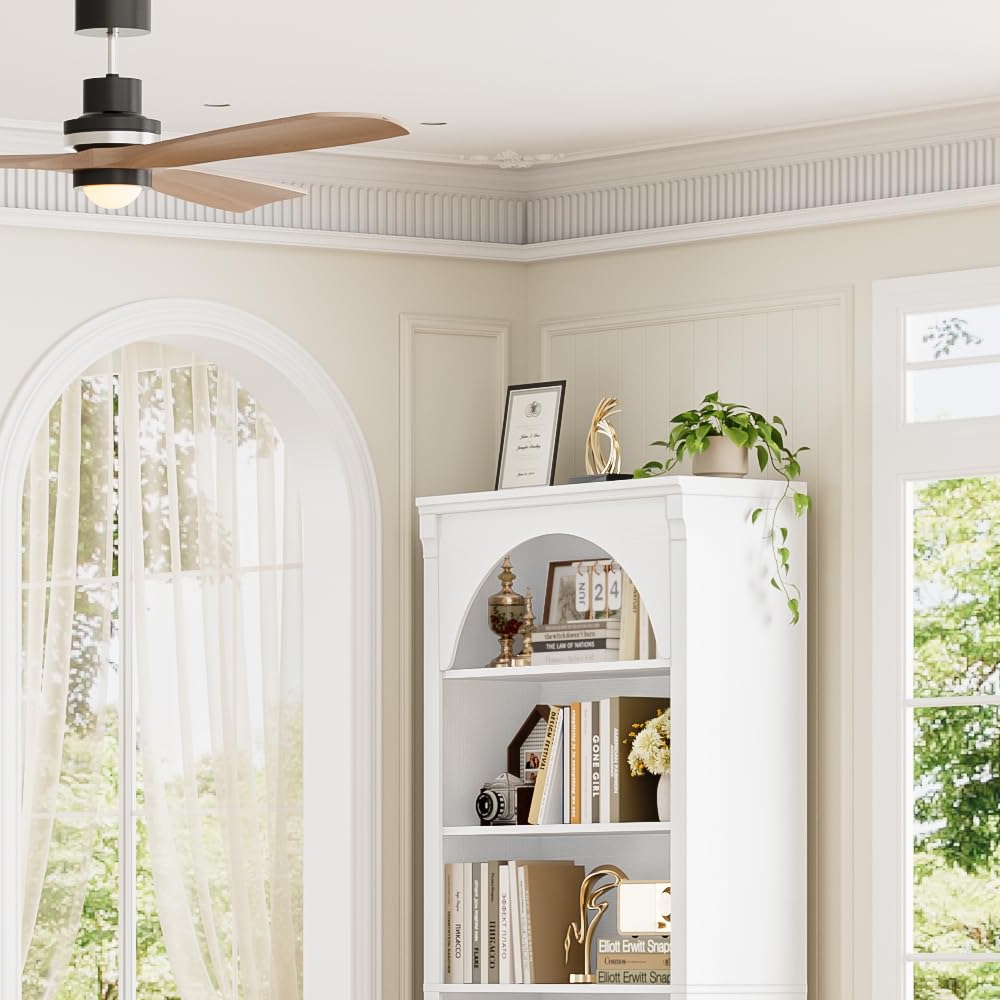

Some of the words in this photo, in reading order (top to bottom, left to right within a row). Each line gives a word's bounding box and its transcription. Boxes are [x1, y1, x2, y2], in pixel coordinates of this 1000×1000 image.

[594, 583, 603, 600] 2
[610, 581, 619, 598] 4
[546, 711, 557, 738] DESIGN
[598, 939, 621, 953] Elliott
[622, 939, 646, 953] Erwitt
[598, 971, 621, 984] Elliott
[623, 971, 647, 984] Erwitt
